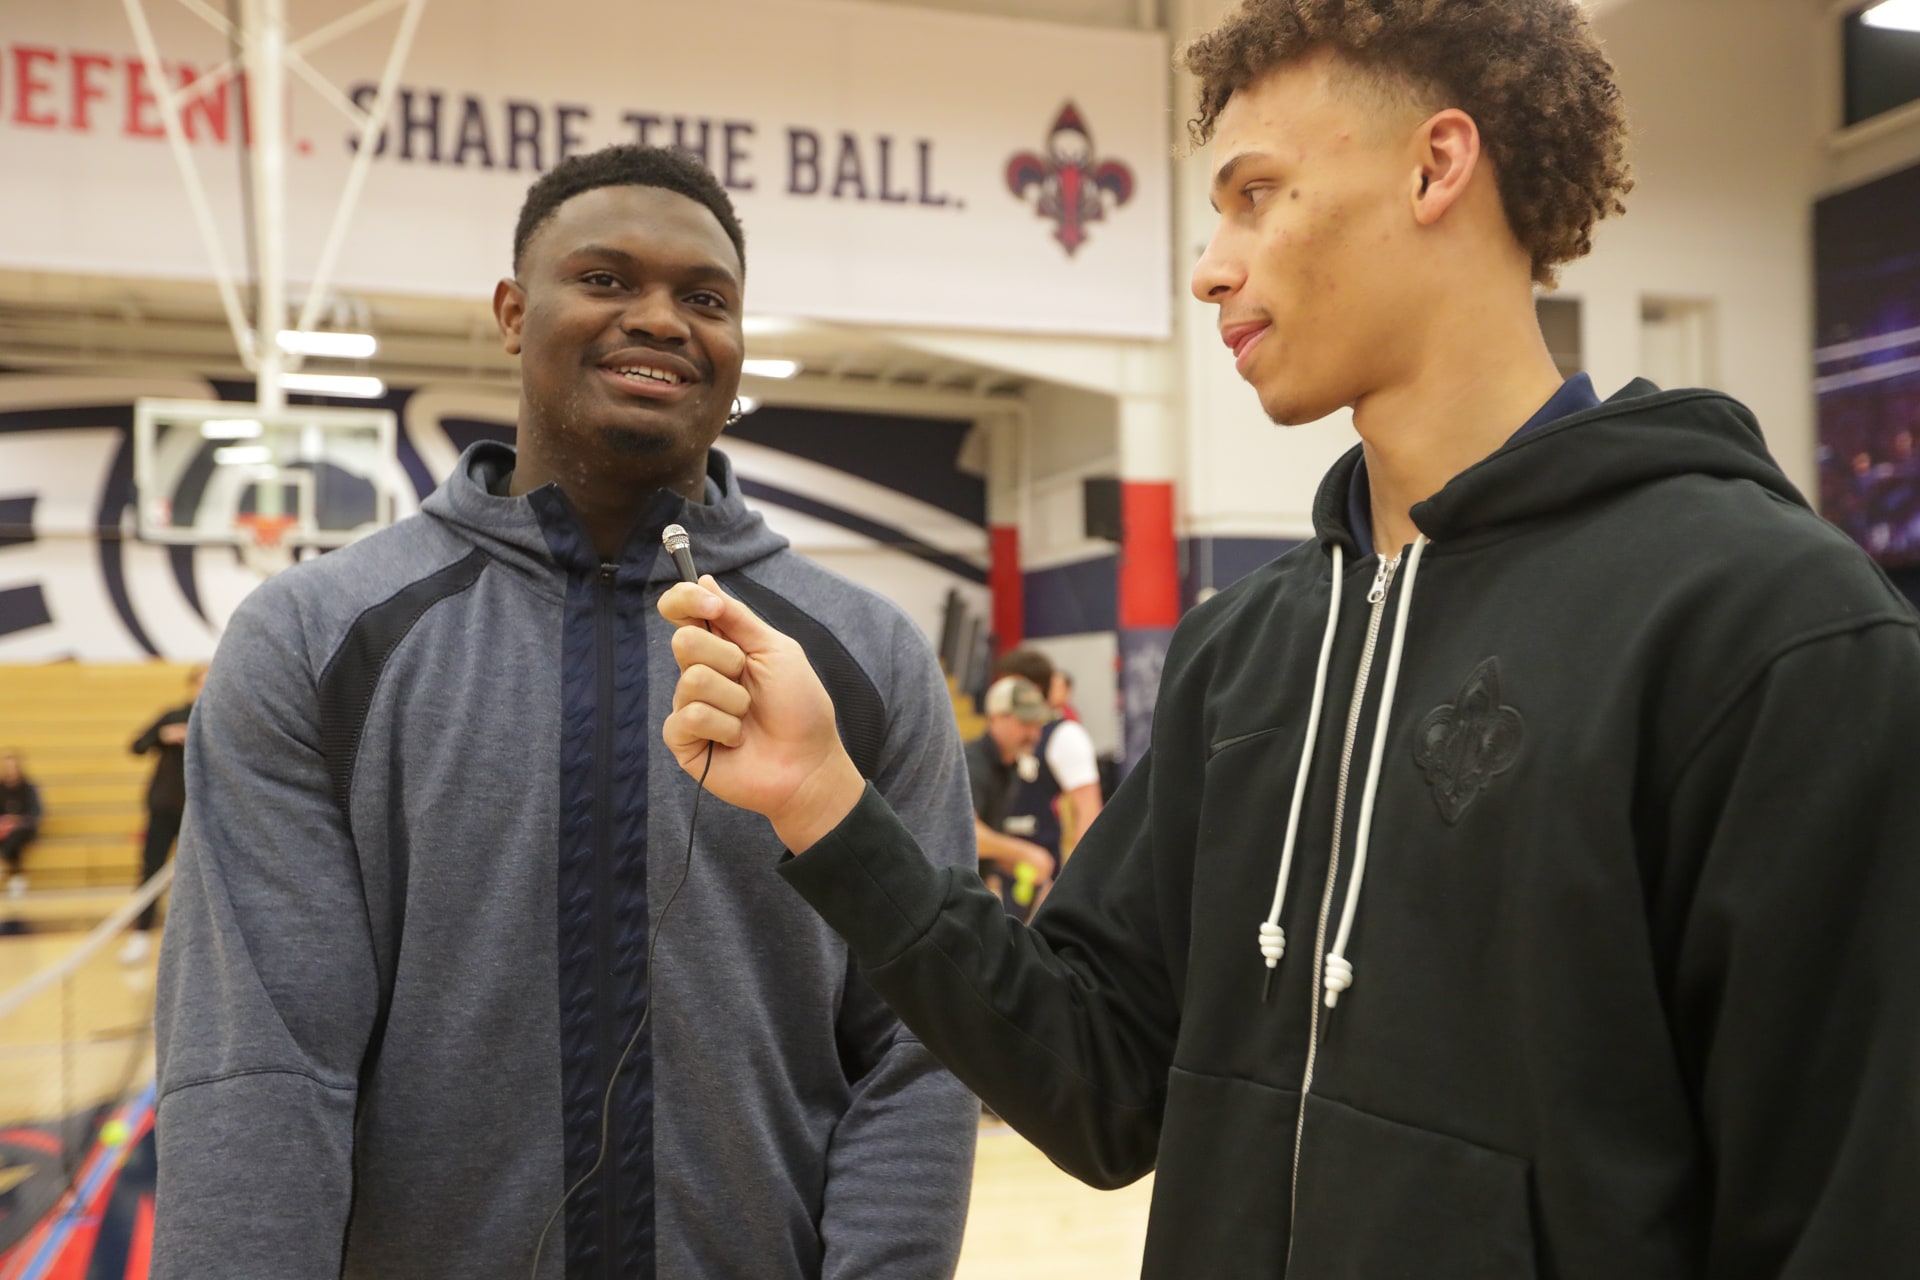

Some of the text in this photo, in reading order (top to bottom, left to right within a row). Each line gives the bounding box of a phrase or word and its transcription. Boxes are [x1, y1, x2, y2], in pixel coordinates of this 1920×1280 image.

[0, 42, 965, 209] EFEN. SHARE THE BALL.
